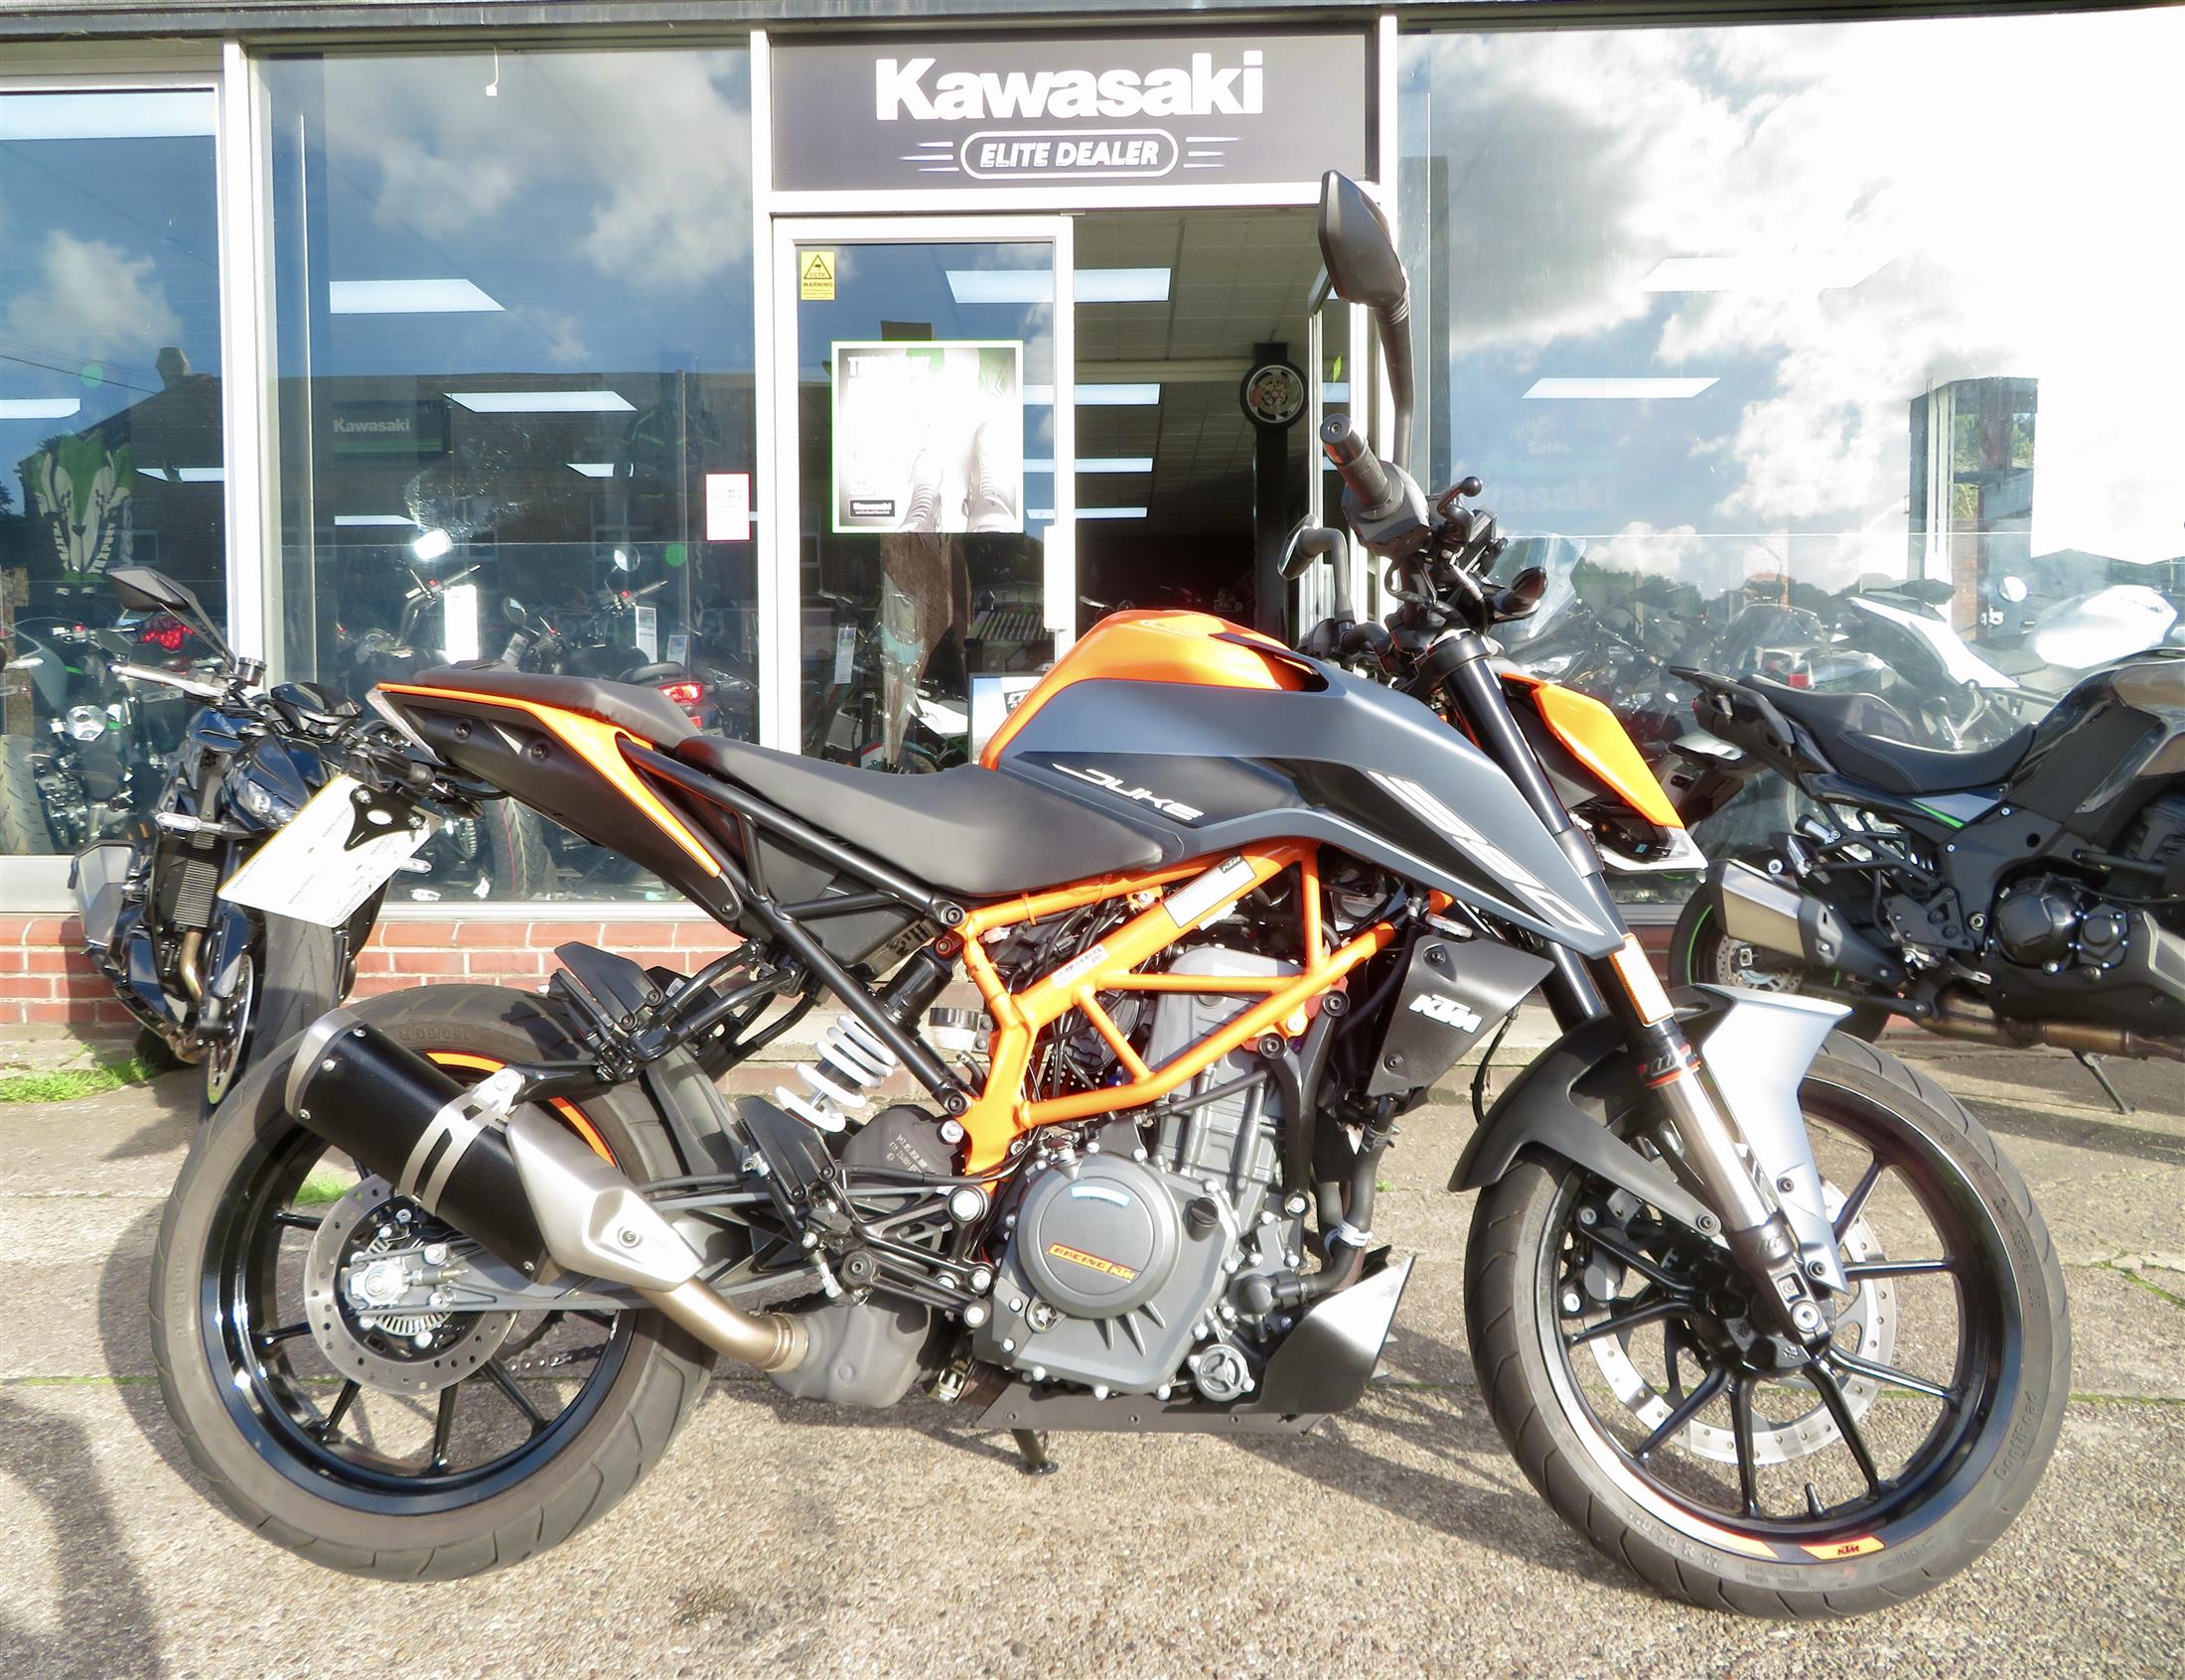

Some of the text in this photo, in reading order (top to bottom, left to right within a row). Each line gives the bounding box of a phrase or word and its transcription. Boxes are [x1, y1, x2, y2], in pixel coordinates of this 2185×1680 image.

[876, 51, 1263, 120] Kawasaki
[979, 140, 1159, 168] ELITE DEALER
[334, 418, 410, 432] Kawasaki
[1052, 763, 1205, 821] DUKE
[1408, 994, 1484, 1034] KTM
[1054, 1247, 1106, 1269] RACING
[1837, 1544, 1860, 1556] KTM
